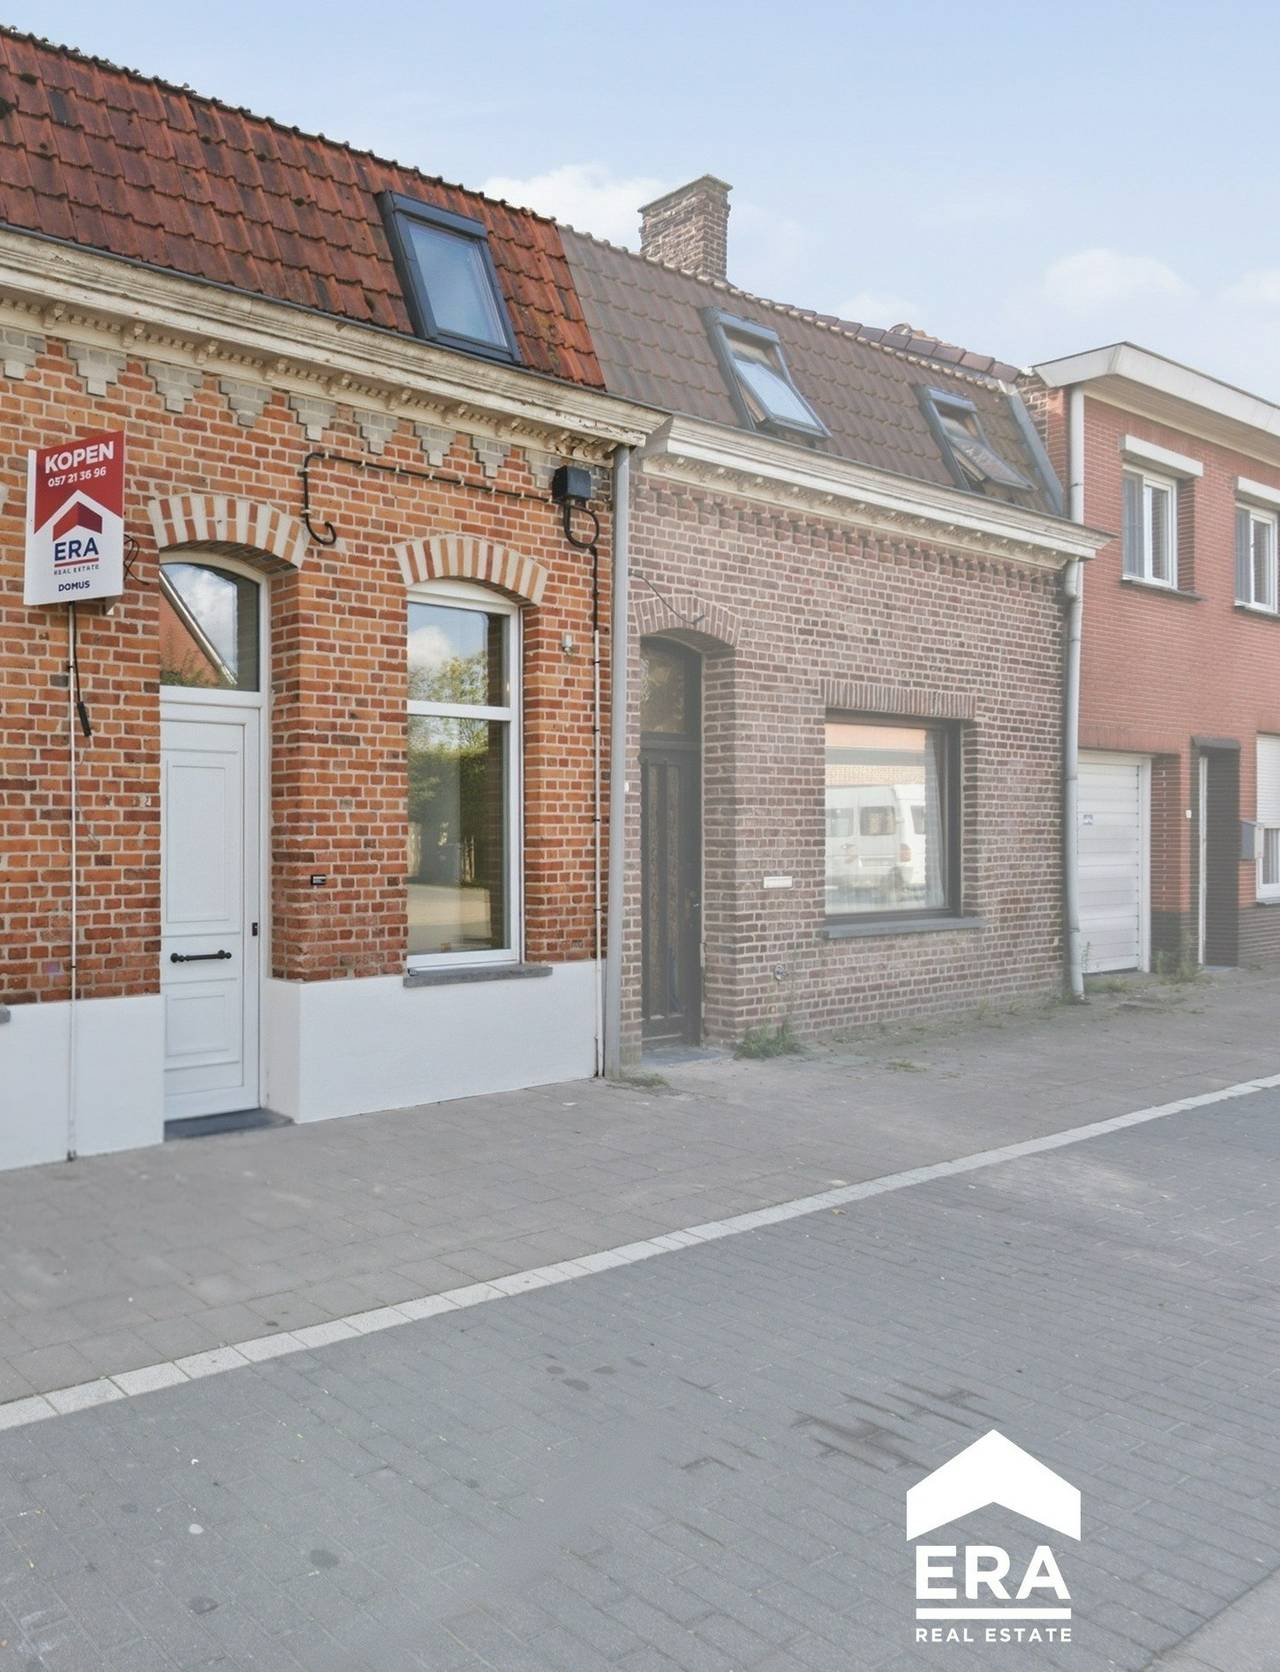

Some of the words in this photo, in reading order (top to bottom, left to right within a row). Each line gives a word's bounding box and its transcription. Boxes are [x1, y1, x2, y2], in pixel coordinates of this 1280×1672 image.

[45, 441, 114, 474] KOPEN
[68, 473, 78, 484] 21
[80, 469, 92, 480] 36
[94, 466, 107, 478] 96
[54, 537, 99, 561] ERA
[58, 580, 90, 591] DOMUS
